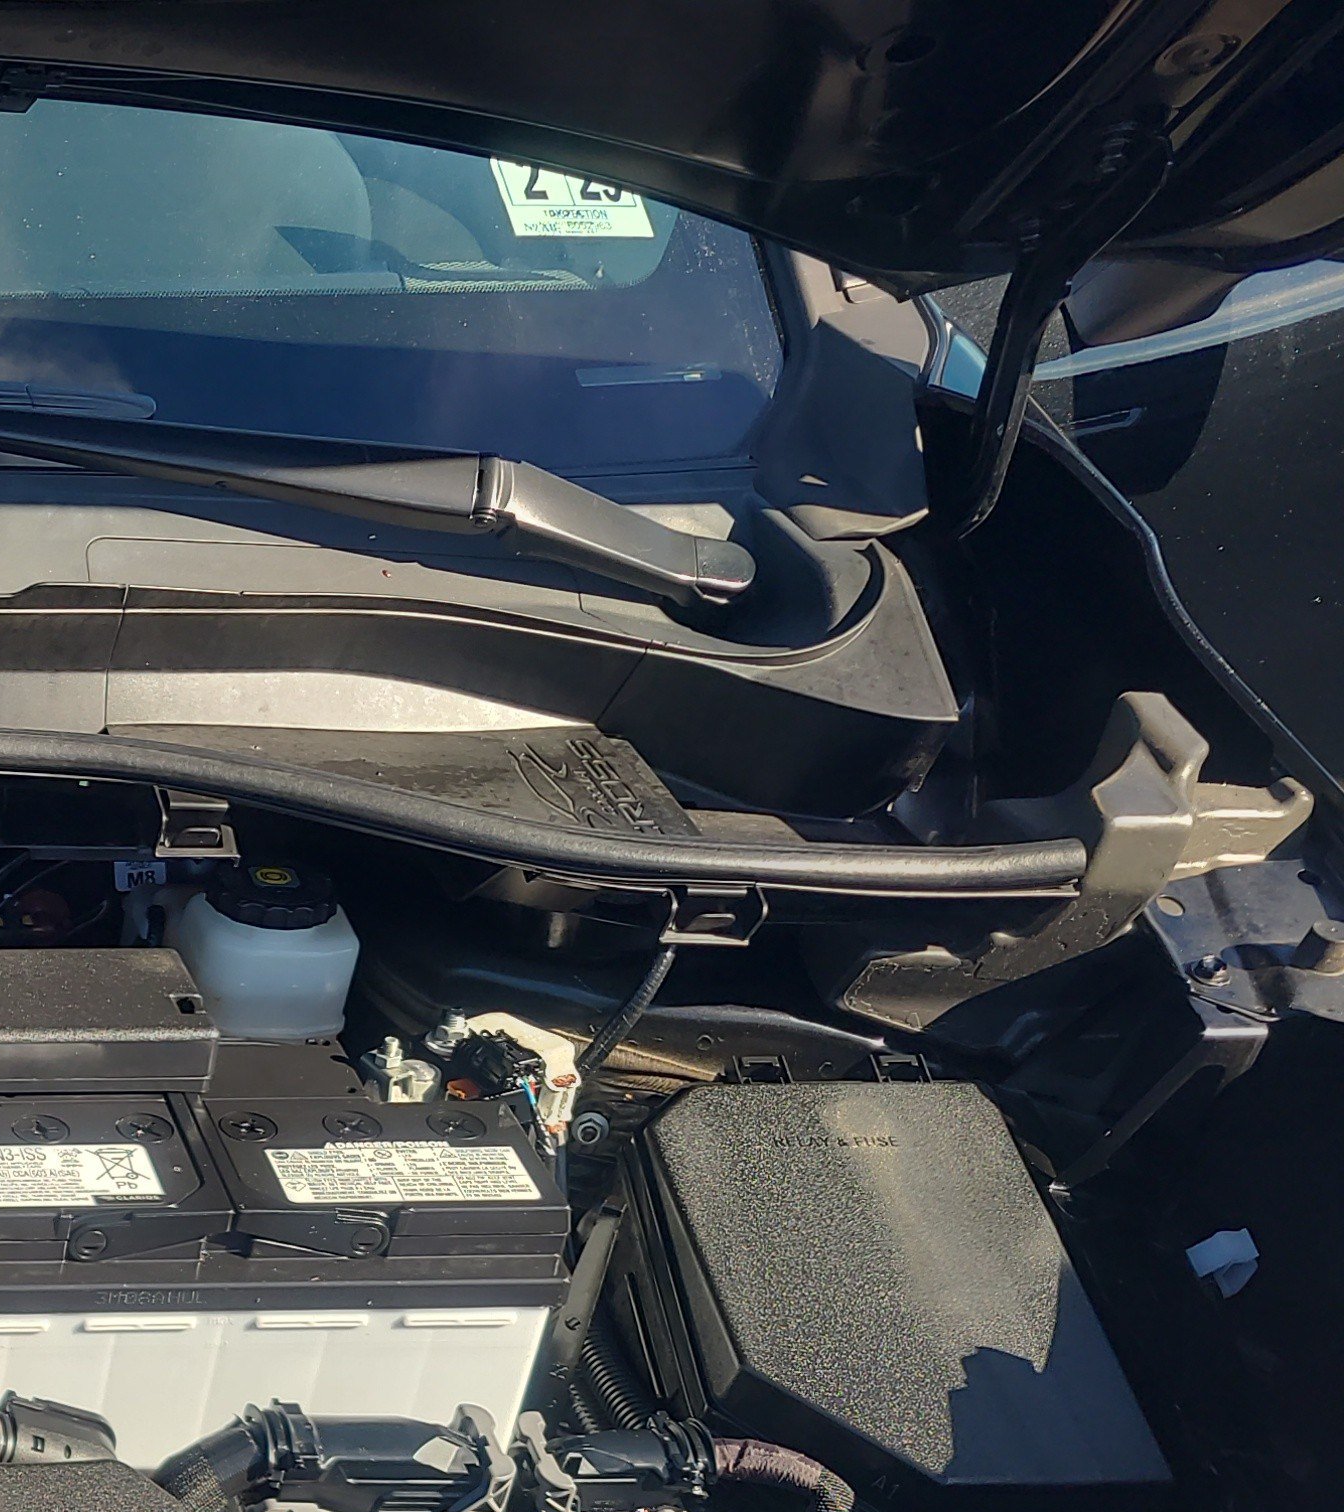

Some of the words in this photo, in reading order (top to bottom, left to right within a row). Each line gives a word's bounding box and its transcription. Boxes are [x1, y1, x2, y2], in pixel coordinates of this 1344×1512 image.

[566, 738, 664, 834] ROSS
[853, 1136, 899, 1148] FUSE
[116, 1181, 139, 1190] Pb
